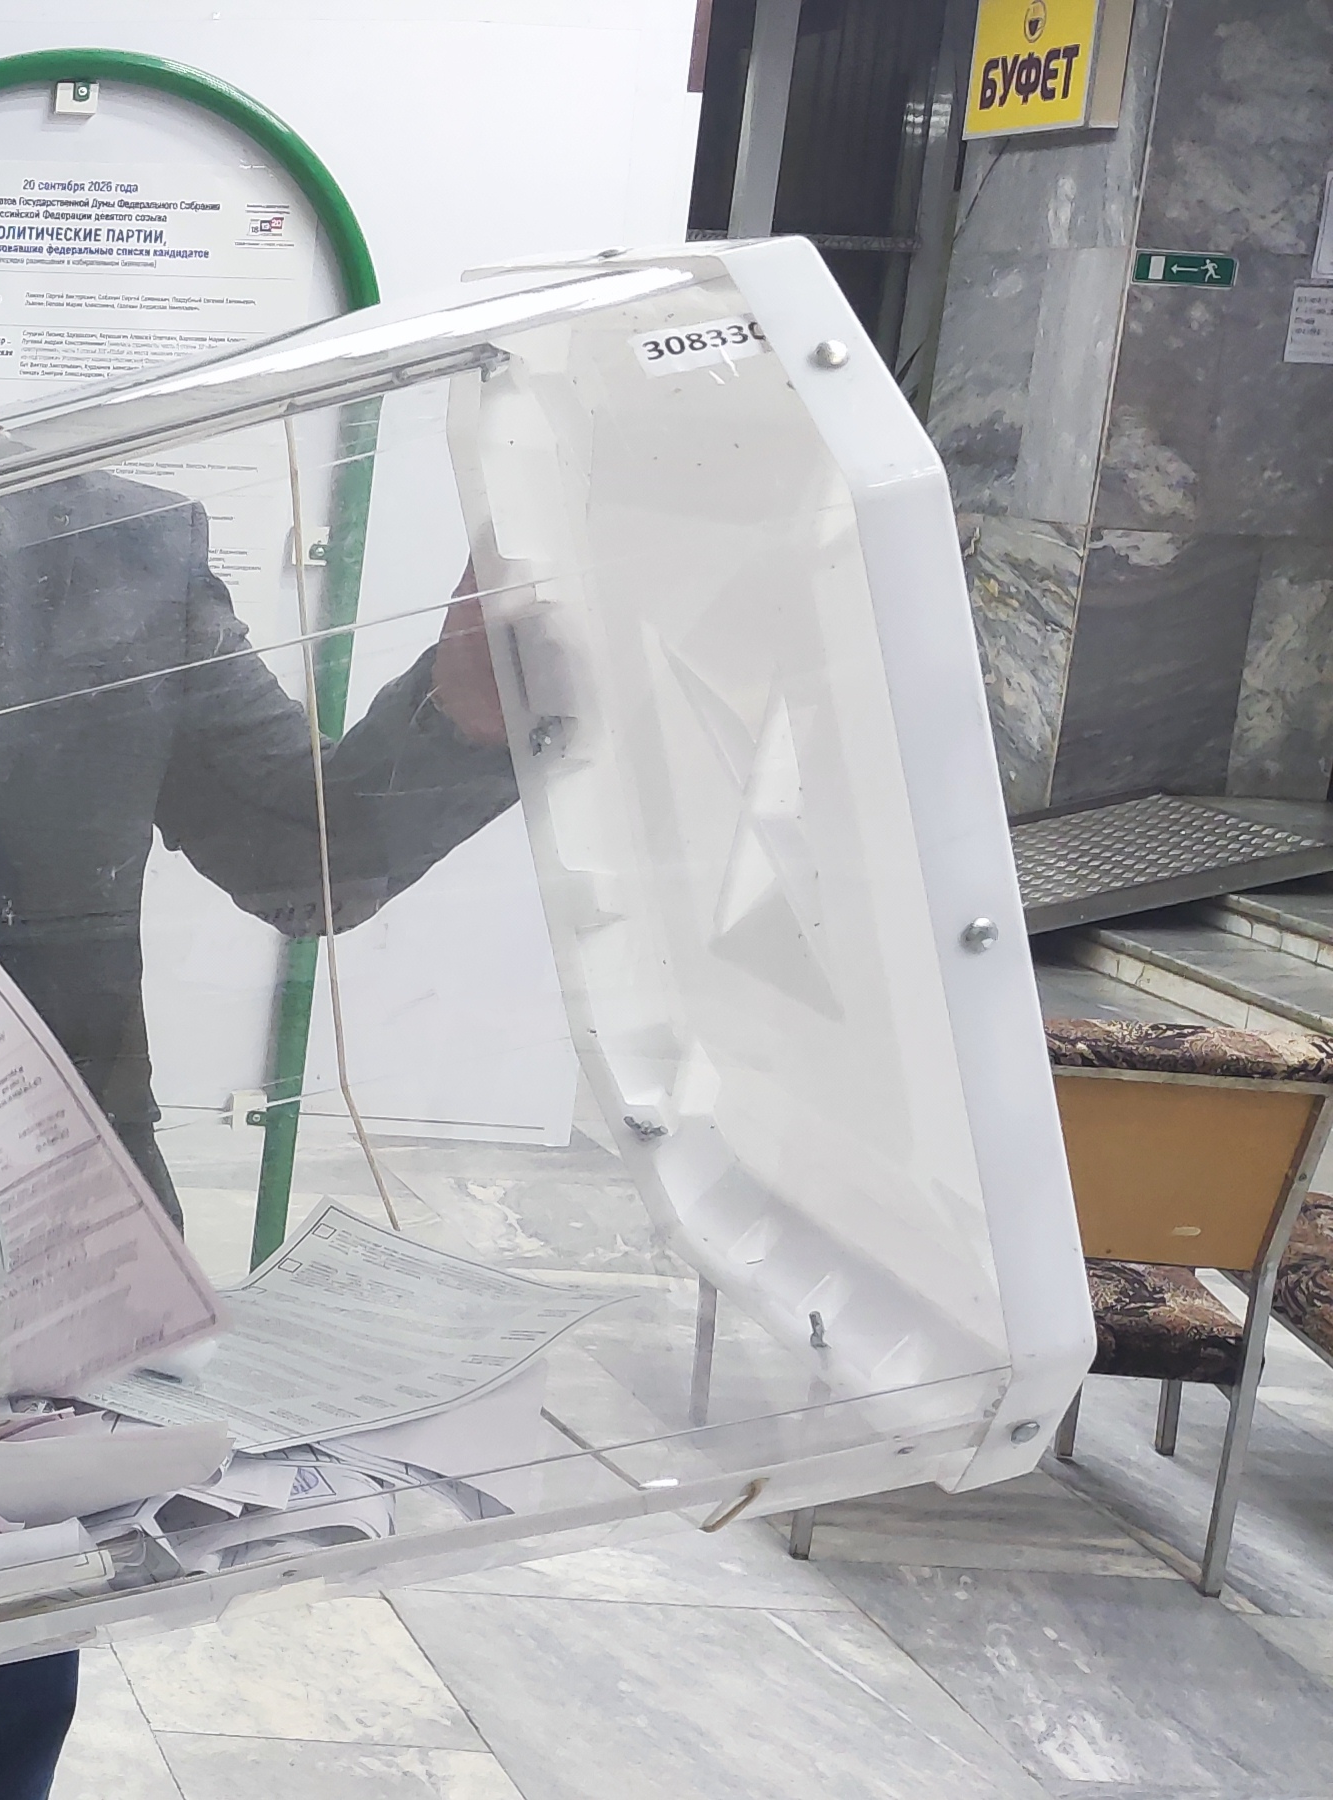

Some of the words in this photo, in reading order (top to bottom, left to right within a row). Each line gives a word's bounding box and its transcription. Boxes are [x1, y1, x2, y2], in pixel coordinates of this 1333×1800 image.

[978, 44, 1081, 111] БУФЕТ
[23, 179, 35, 190] 20
[38, 181, 85, 193] сентября
[88, 181, 112, 192] 2026
[115, 184, 138, 193] года
[19, 197, 89, 208] Государственной
[91, 200, 115, 210] Думы
[117, 200, 178, 211] Федерального
[106, 228, 167, 246] ПАРТИИ,
